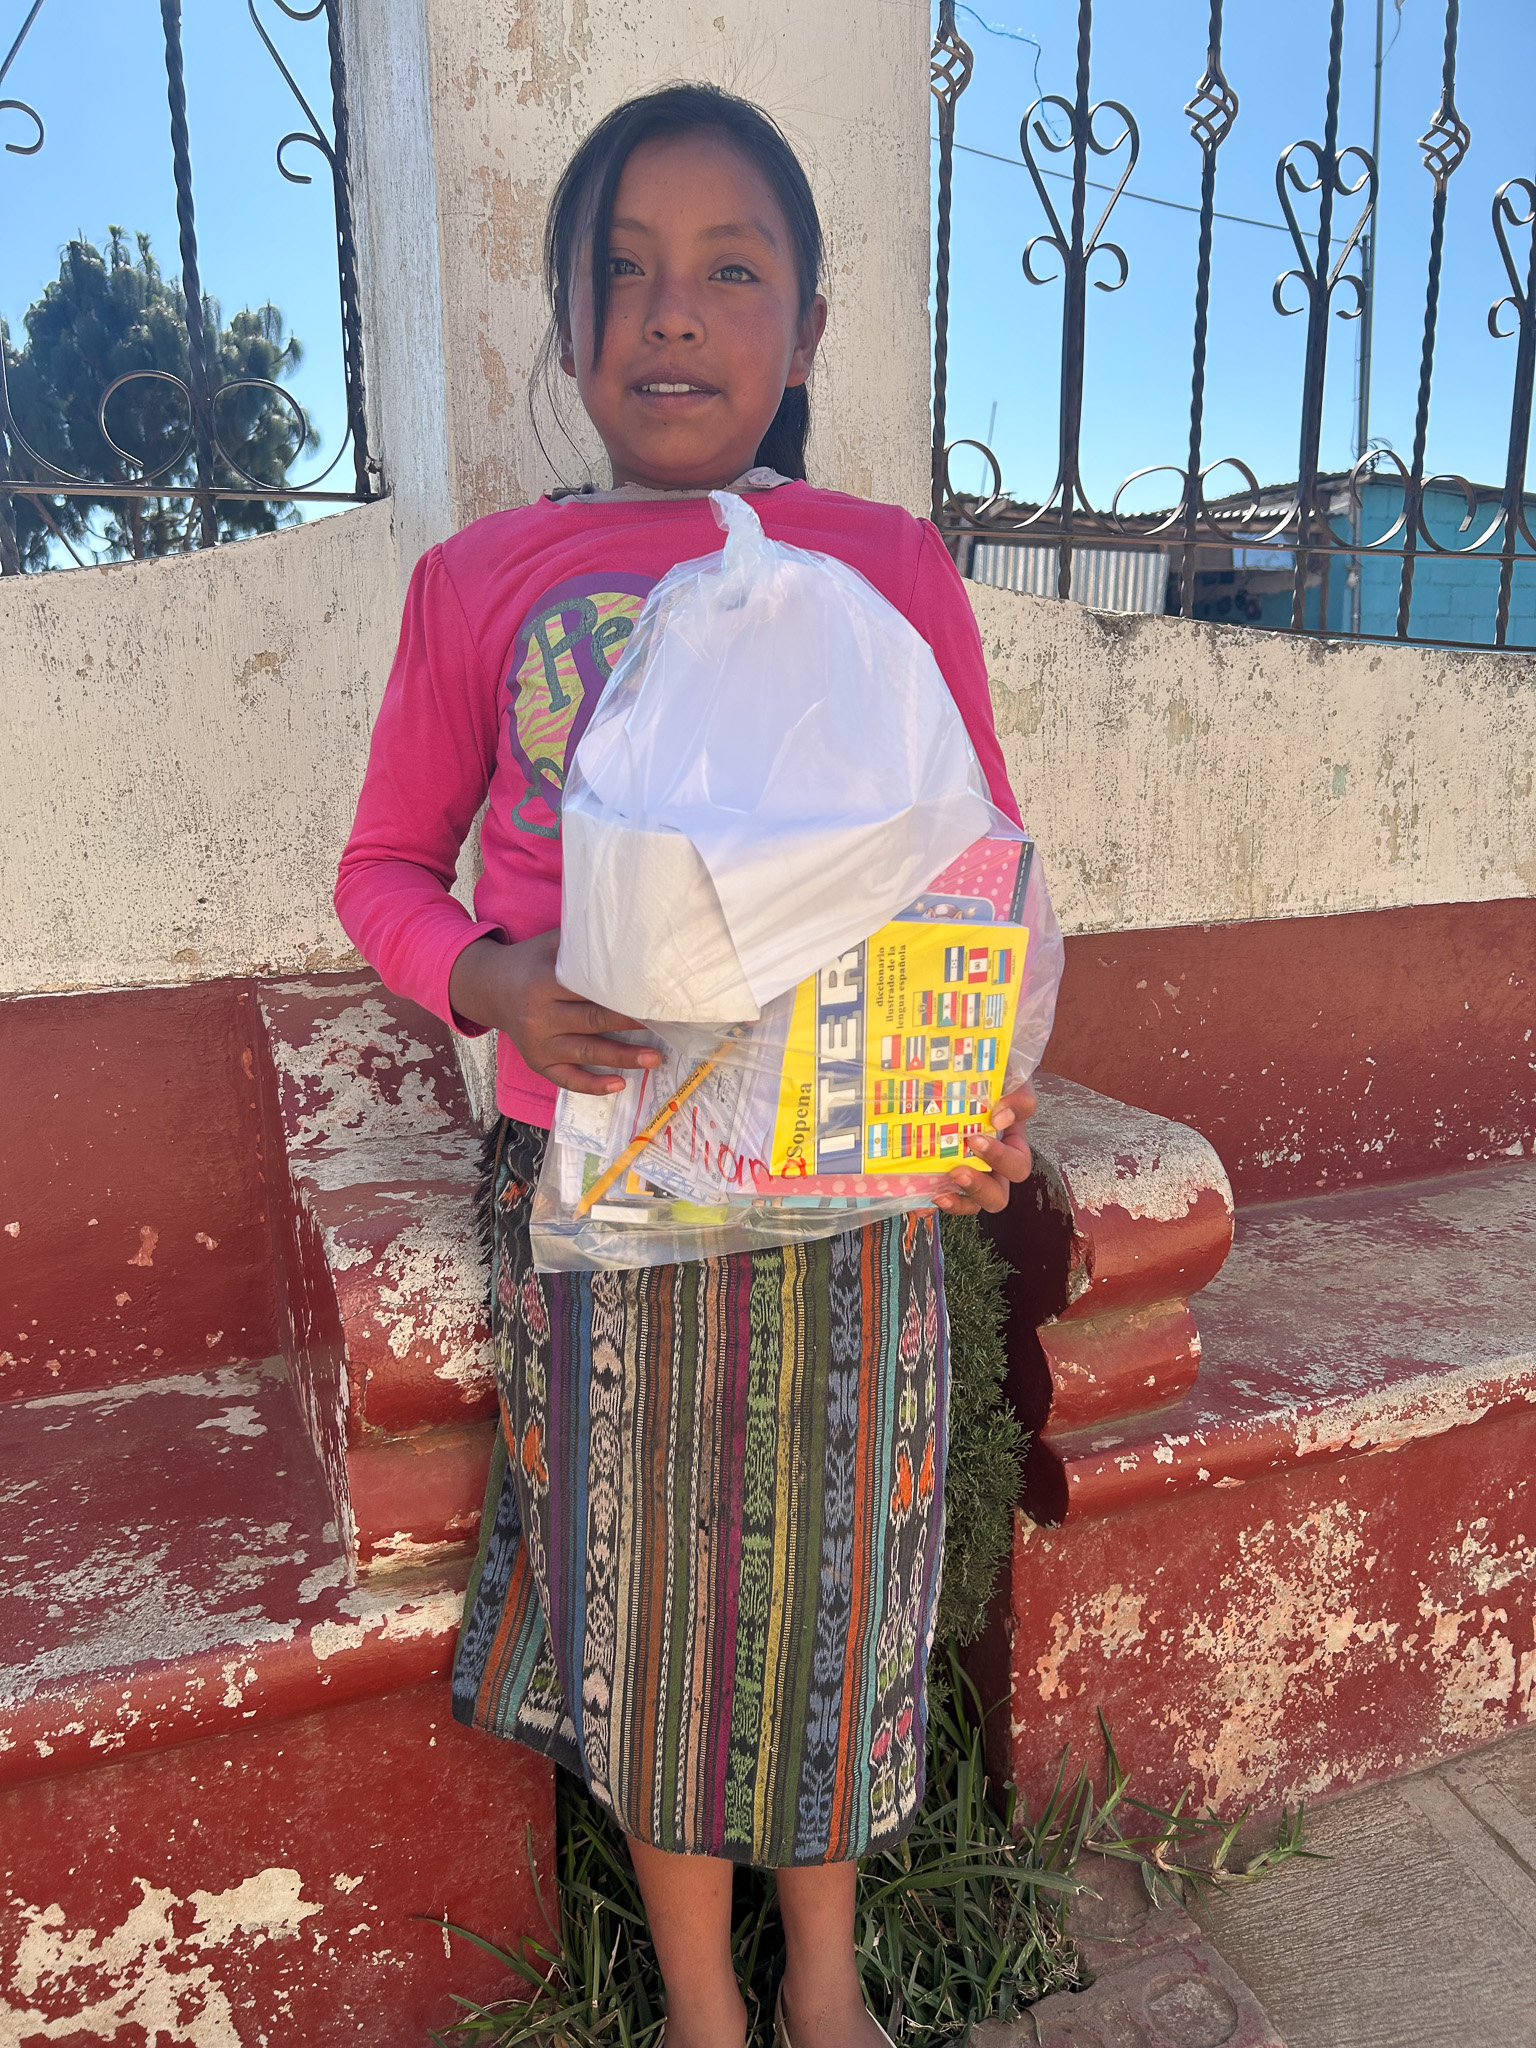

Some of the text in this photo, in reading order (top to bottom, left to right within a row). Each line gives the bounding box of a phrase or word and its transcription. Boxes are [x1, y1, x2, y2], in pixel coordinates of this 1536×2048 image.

[876, 947, 885, 1007] diccionario
[886, 946, 896, 1022] ilustrado de la
[896, 945, 908, 1029] lengua española
[786, 1082, 813, 1159] Sopena
